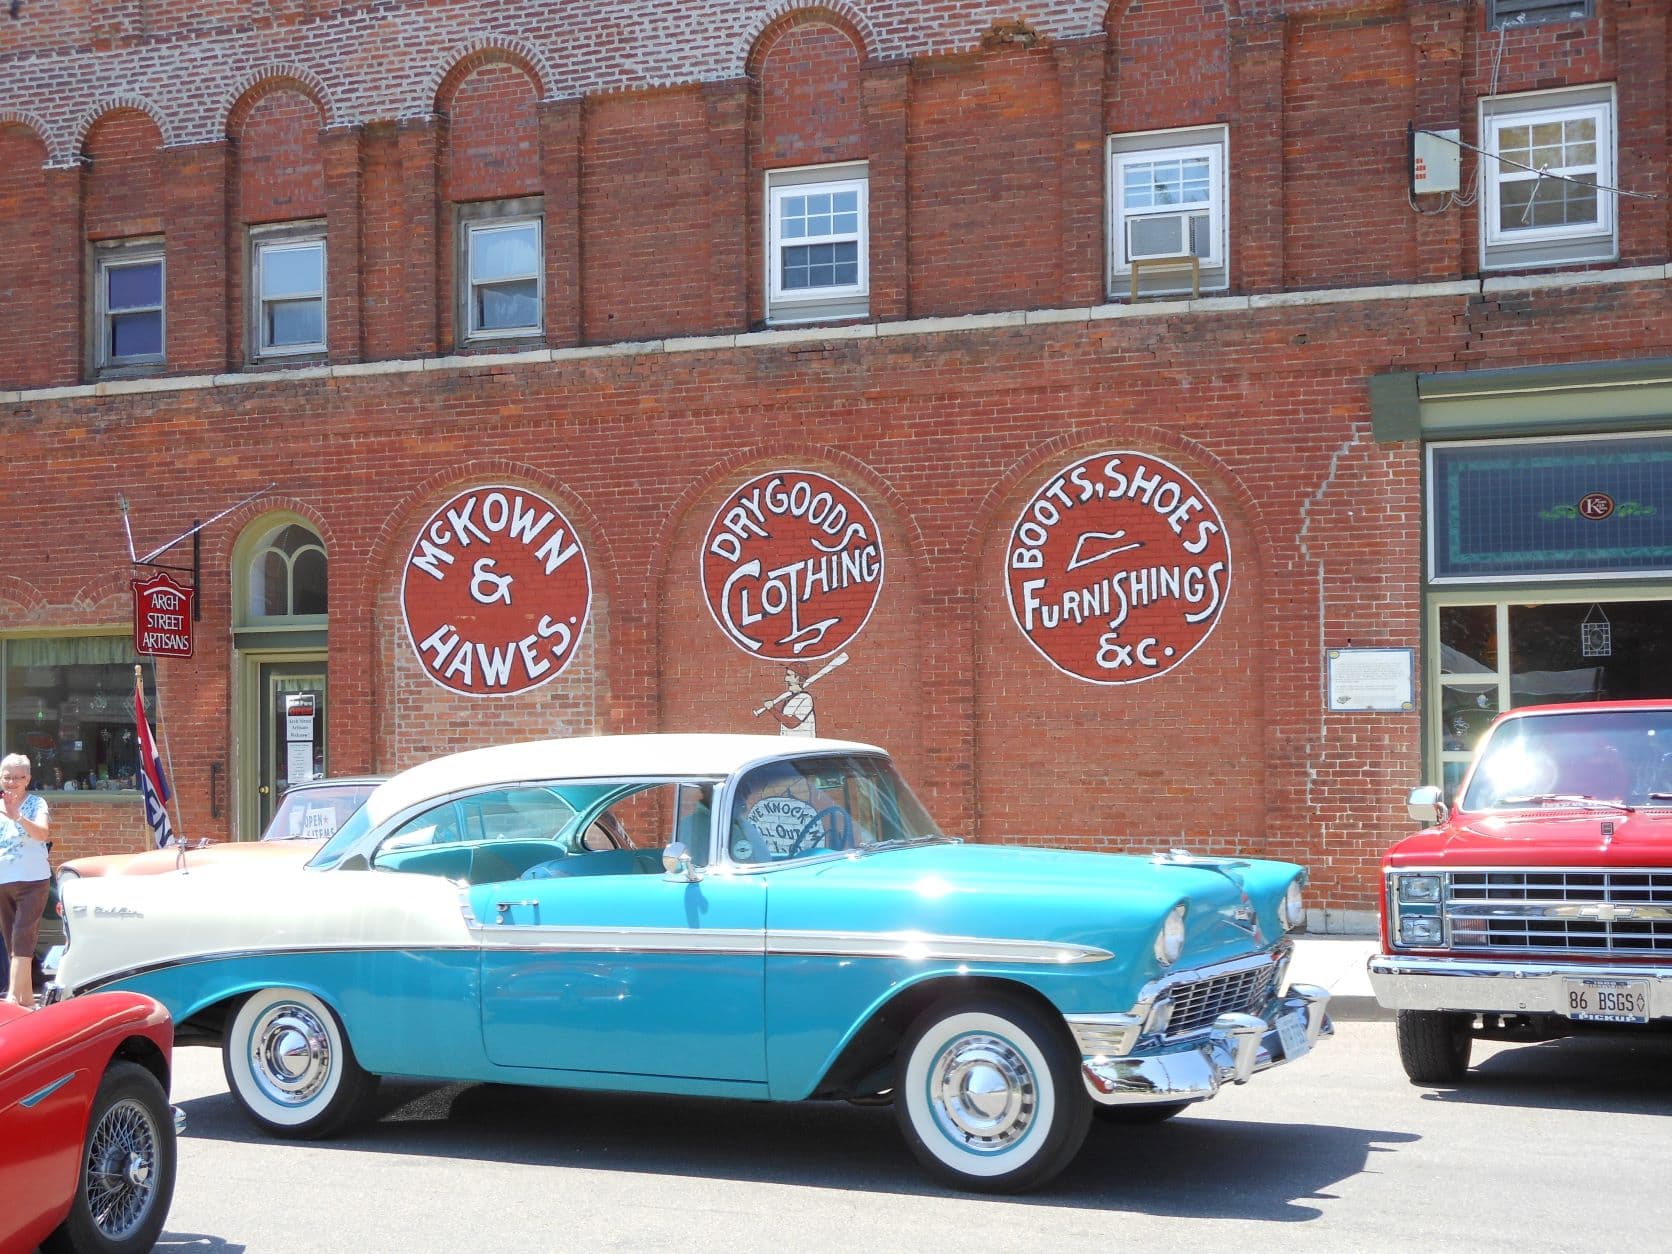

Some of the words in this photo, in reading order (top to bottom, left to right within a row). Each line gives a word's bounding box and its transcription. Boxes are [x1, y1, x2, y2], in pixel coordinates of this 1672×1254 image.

[1104, 458, 1219, 554] SHOES
[470, 557, 514, 605] &
[151, 593, 179, 611] ARCH
[721, 545, 880, 654] CLOTHING
[1023, 561, 1224, 631] FURNISHINGS
[147, 612, 185, 631] STREET
[142, 631, 190, 651] ARTISANS
[749, 808, 763, 823] WE
[764, 802, 809, 824] KNOCK
[775, 824, 801, 840] OUT
[1569, 991, 1588, 1010] 86
[1598, 992, 1634, 1012] BSGS
[1579, 1014, 1636, 1022] PICKUP
